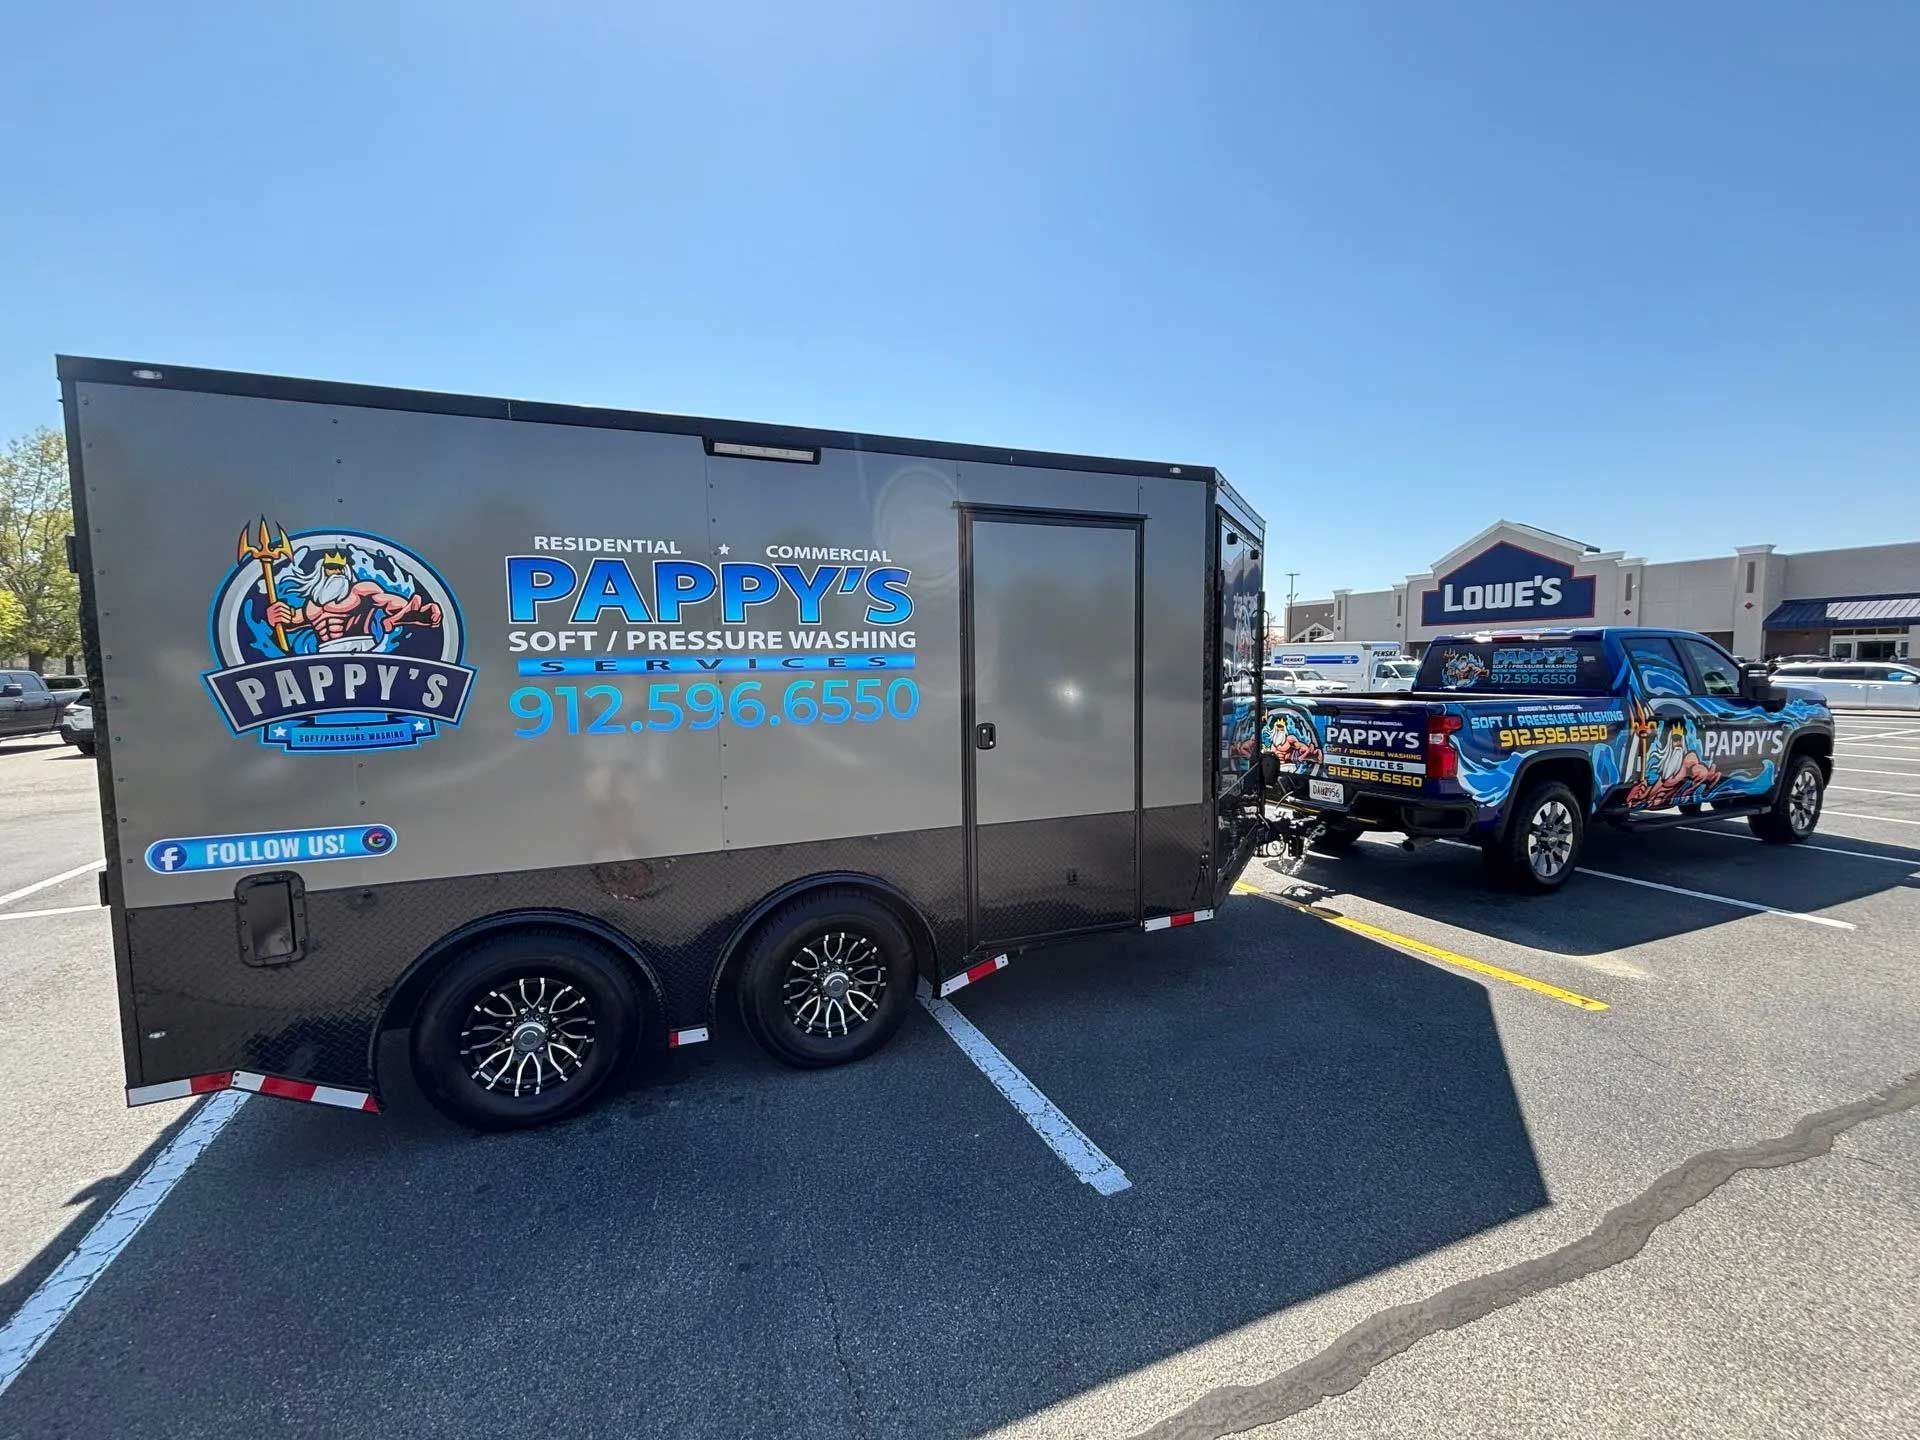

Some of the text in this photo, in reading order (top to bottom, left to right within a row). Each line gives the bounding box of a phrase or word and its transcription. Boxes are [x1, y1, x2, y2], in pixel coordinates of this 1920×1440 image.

[533, 535, 892, 563] RESIDENTIAL COMMERCIAL
[505, 555, 915, 626] PAPPY'S
[1443, 575, 1563, 613] LOWE'S
[508, 630, 917, 652] SOFT / PRESSURE WASHING
[540, 656, 888, 673] SERVICES
[1492, 650, 1578, 664] PAPPY'S
[235, 663, 449, 717] PAPPY'S
[1491, 674, 1576, 684] 912.596.6550
[509, 677, 920, 739] 912.596.6550
[1471, 715, 1502, 729] SOFT
[1517, 712, 1577, 726] PRESSURE
[1579, 711, 1624, 723] WASHING
[368, 730, 405, 741] WASHING
[1326, 727, 1420, 749] PAPPY'S
[1500, 725, 1608, 747] 912.596.6550
[1704, 730, 1783, 757] PAPPY'S
[1340, 757, 1404, 770] SERVICES
[1349, 748, 1385, 757] PRESSURE
[1388, 752, 1422, 760] WASHING
[1328, 765, 1423, 787] 912.596.6550
[206, 837, 300, 865] FOLLOW
[308, 834, 345, 855] US!
